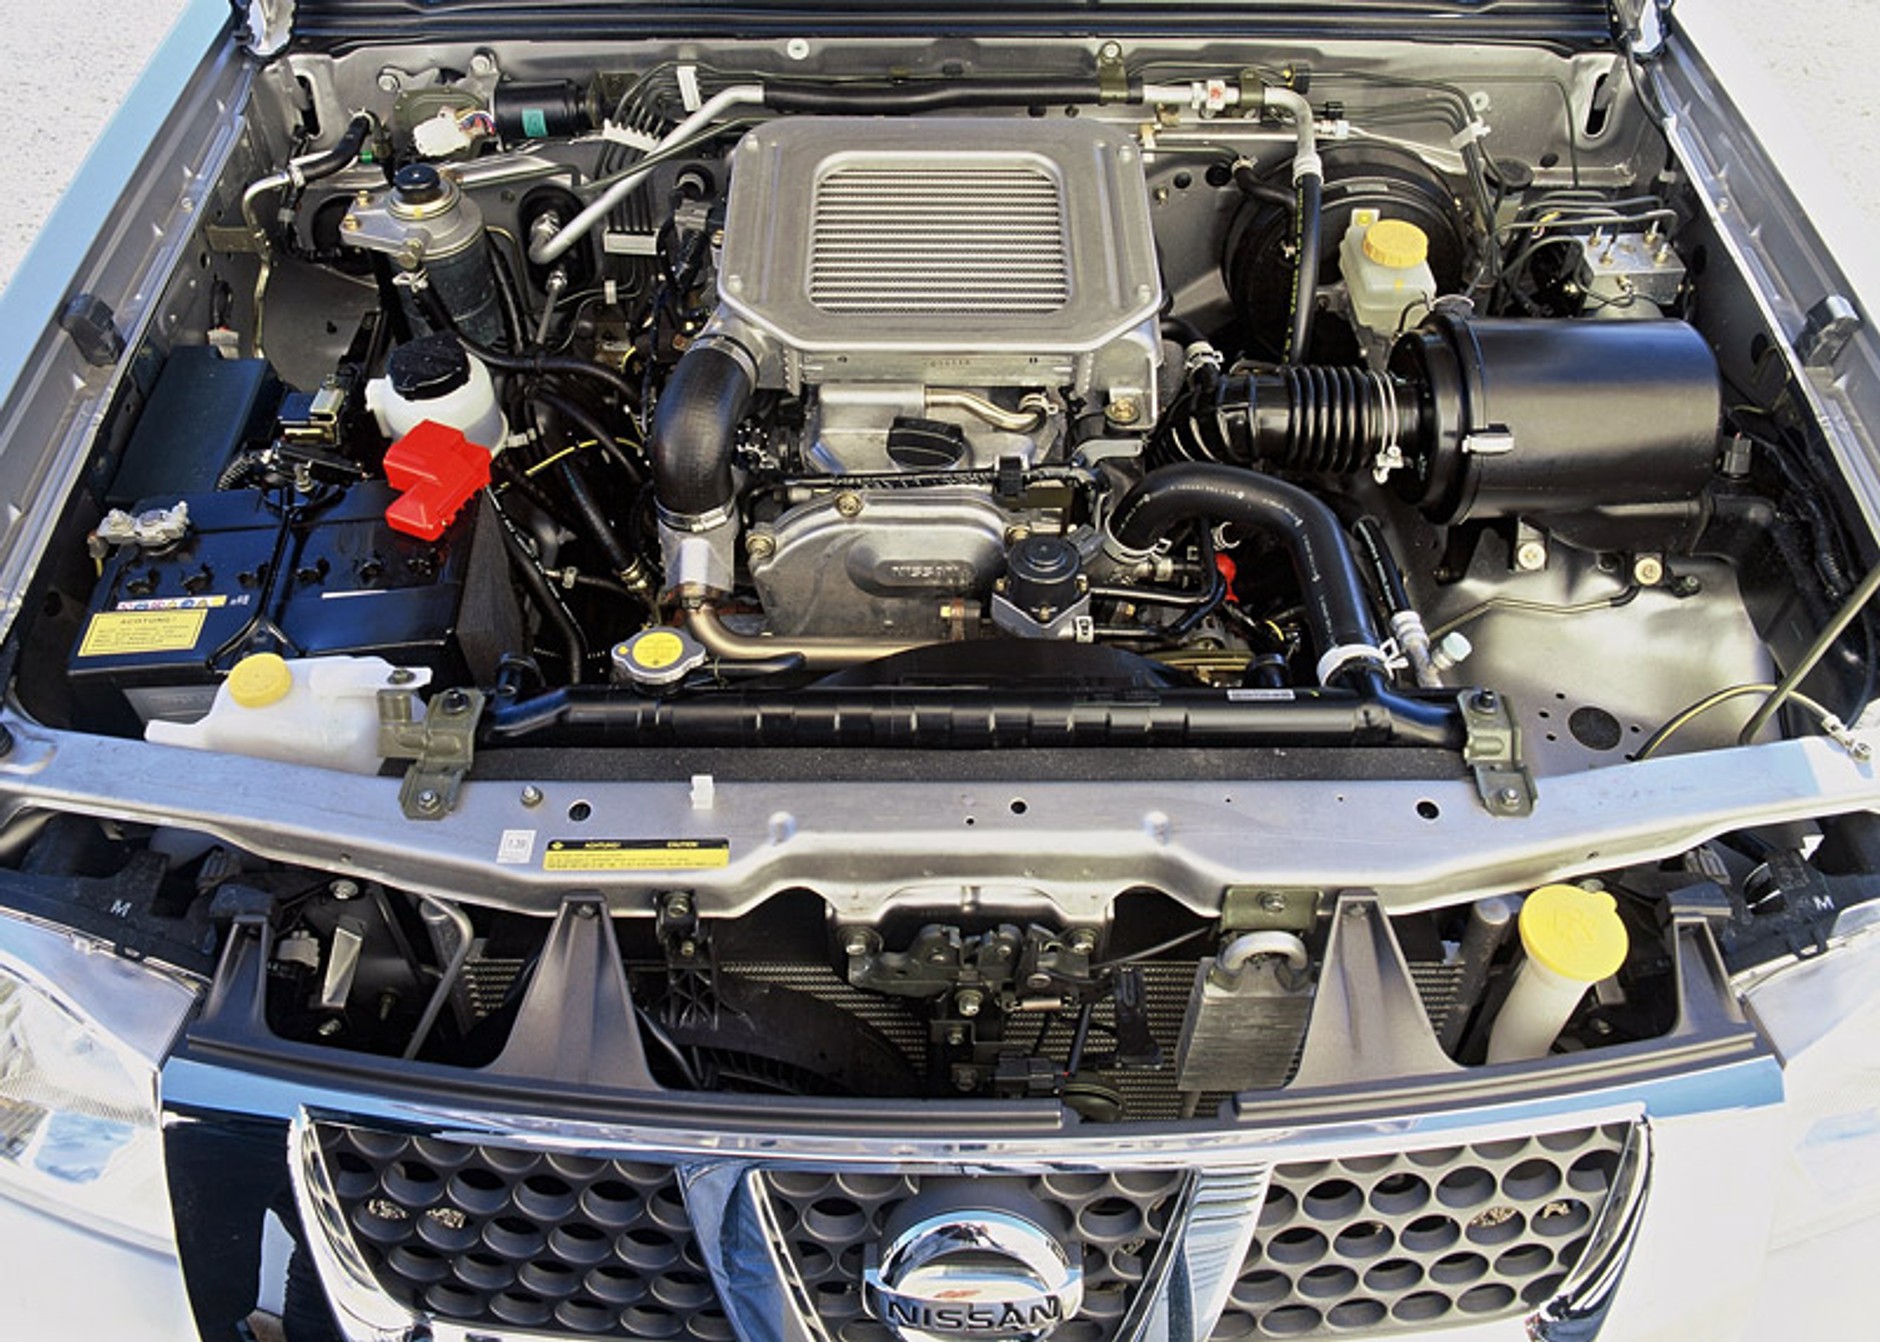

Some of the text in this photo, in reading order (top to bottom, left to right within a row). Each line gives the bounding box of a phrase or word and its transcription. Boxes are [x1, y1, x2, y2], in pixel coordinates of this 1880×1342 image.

[110, 899, 132, 918] M
[1812, 895, 1835, 910] M
[885, 1295, 1063, 1330] NISSAN
